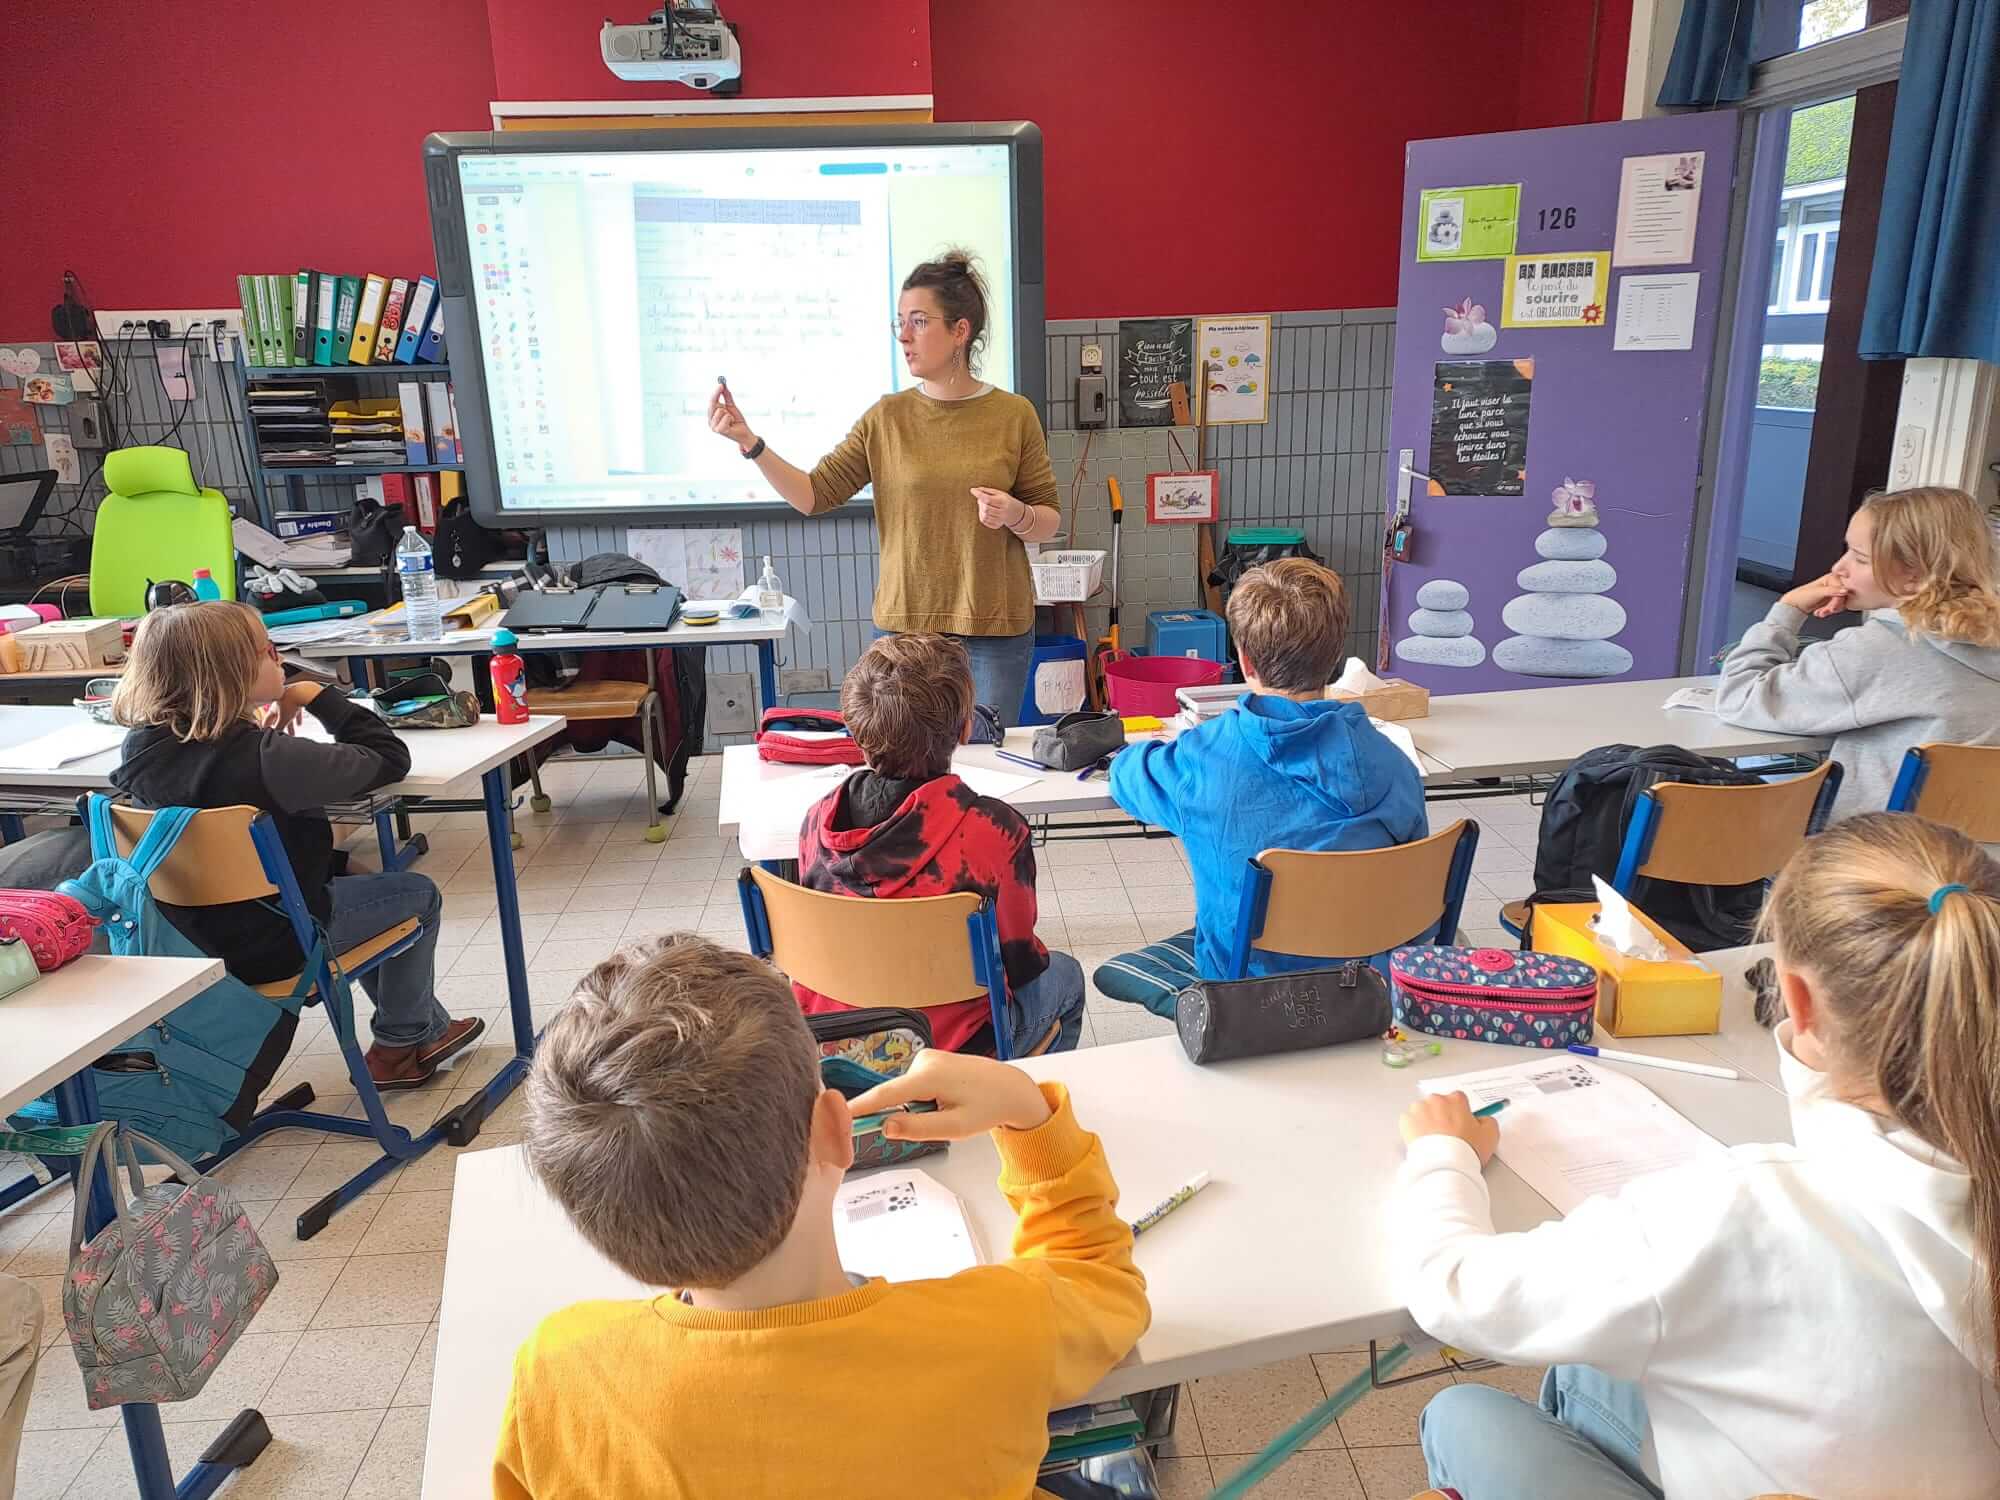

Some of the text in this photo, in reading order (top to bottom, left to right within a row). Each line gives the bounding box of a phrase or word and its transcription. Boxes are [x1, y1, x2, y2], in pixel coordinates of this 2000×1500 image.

[1538, 207, 1576, 231] 126
[1519, 264, 1536, 279] EN
[1526, 292, 1579, 304] sourire
[1139, 373, 1159, 384] tout
[1481, 408, 1505, 421] parce
[1459, 422, 1474, 432] que
[1486, 441, 1506, 449] dans
[1458, 452, 1470, 463] les
